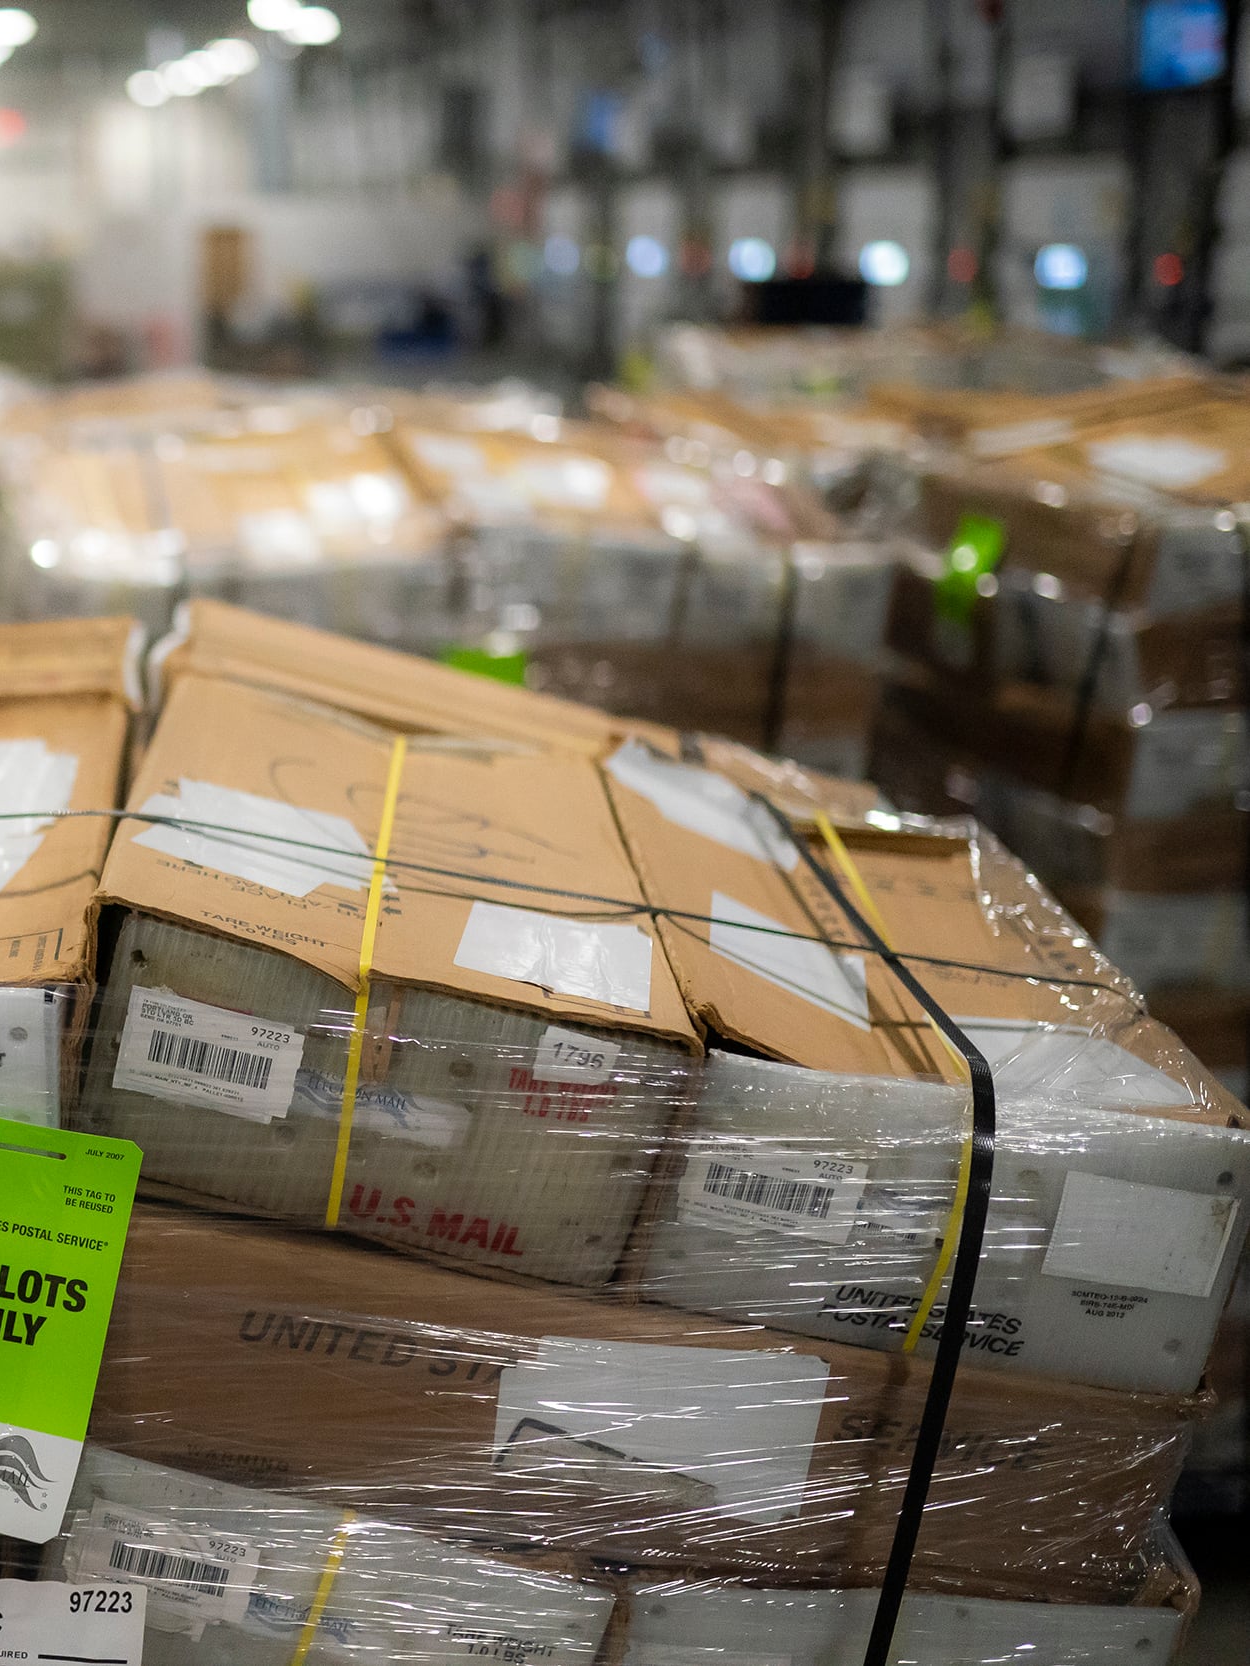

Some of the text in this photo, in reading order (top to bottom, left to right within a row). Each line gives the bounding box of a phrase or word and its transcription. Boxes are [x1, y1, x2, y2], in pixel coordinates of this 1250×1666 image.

[141, 1003, 181, 1017] PORTLAND
[250, 1026, 291, 1044] 97223
[257, 1041, 280, 1051] AUTO
[85, 1148, 125, 1161] JULY 2007
[813, 1160, 854, 1174] 97223
[819, 1173, 844, 1181] AUTO
[63, 1185, 116, 1203] THIS TAG TO
[65, 1197, 114, 1214] BE REUSED
[349, 1184, 523, 1257] U.S. MAIL
[11, 1223, 54, 1242] POSTAL
[817, 1303, 909, 1330] POSTAL
[835, 1284, 1023, 1335] UNITED SATES
[1085, 1308, 1104, 1317] AUG
[238, 1309, 418, 1368] UNITED
[208, 1540, 247, 1558] 97223
[68, 1590, 134, 1614] 97223
[467, 1643, 527, 1665] 1.0 LBS
